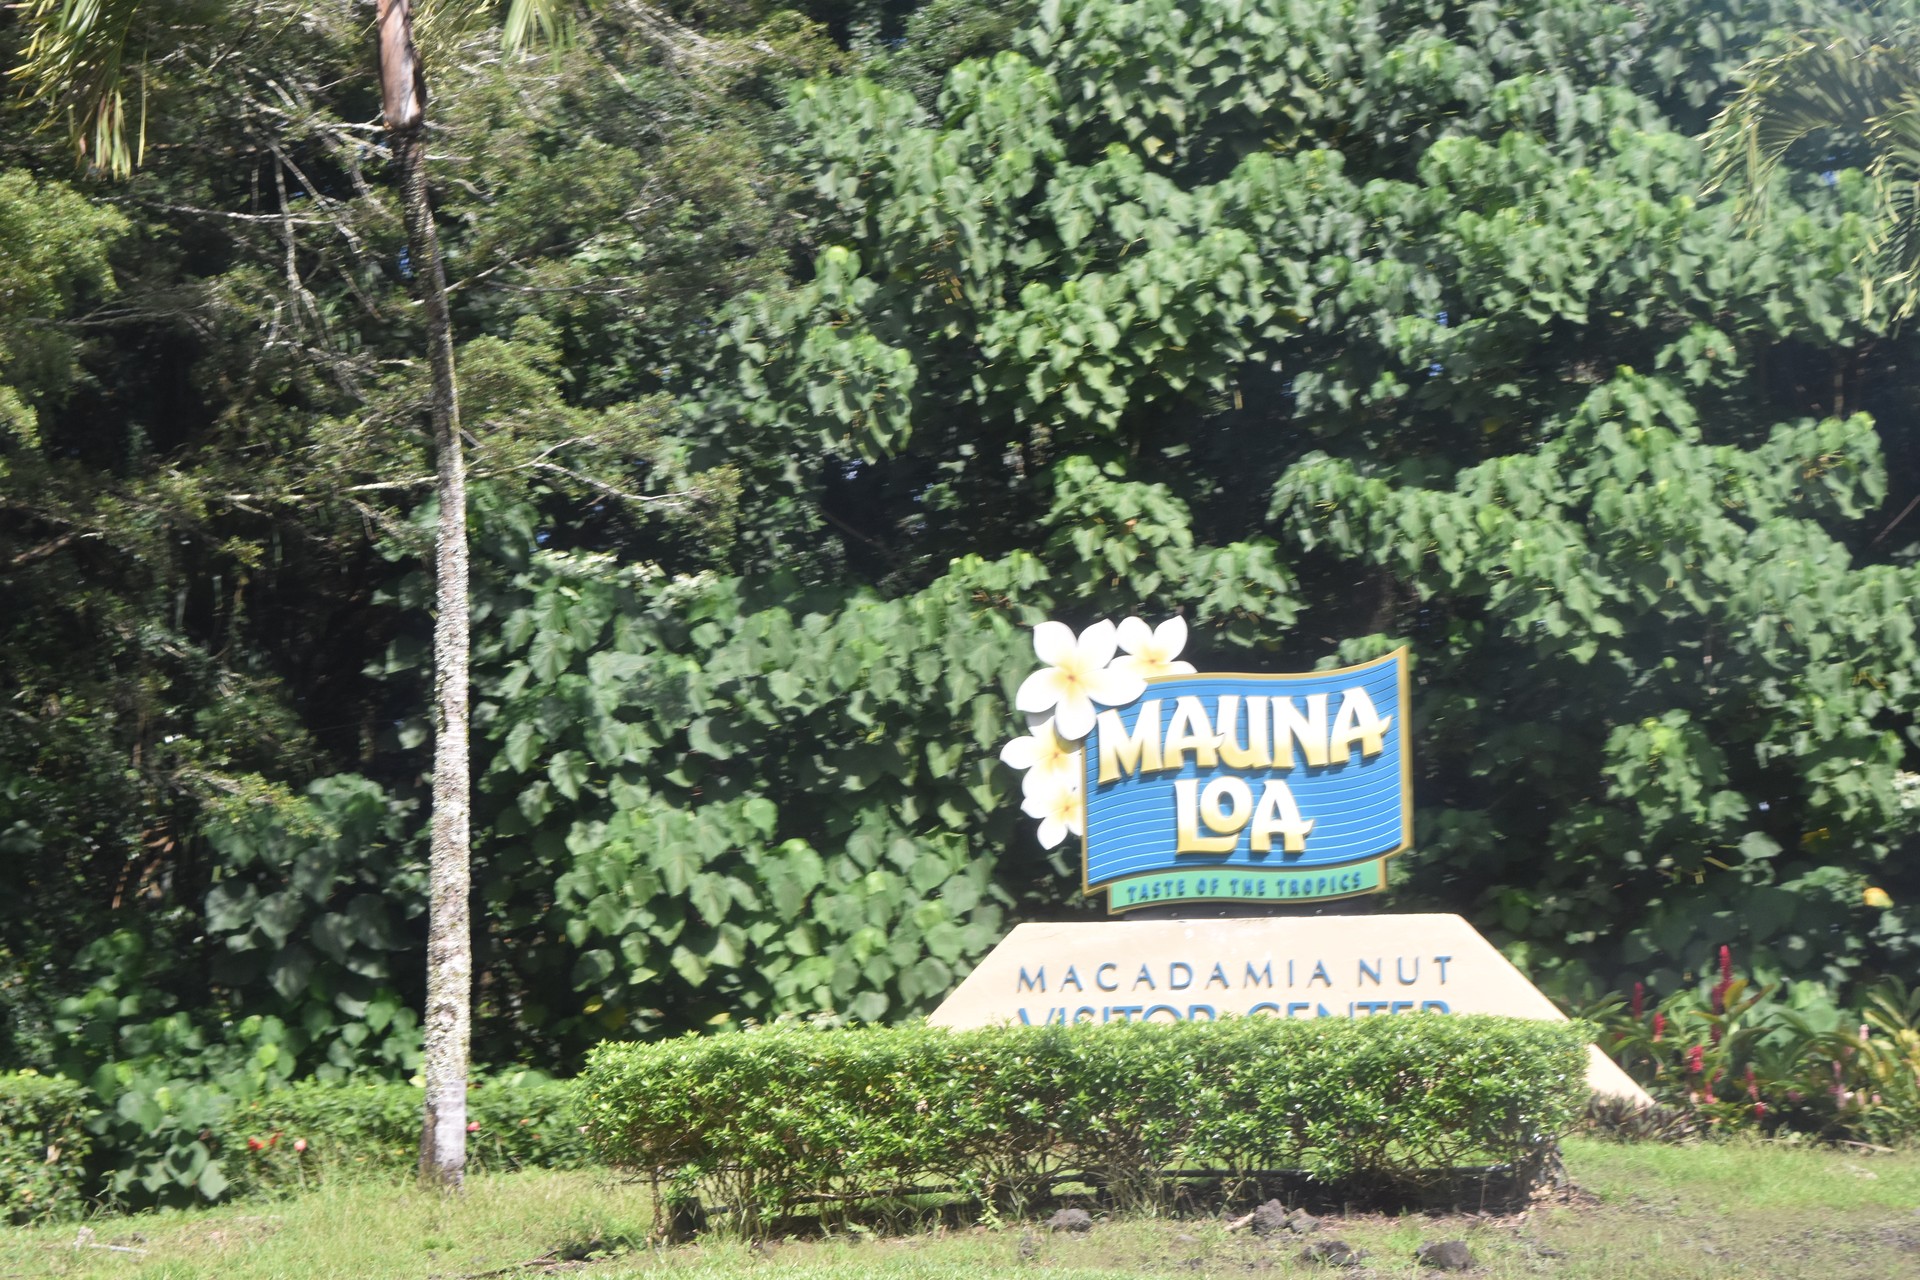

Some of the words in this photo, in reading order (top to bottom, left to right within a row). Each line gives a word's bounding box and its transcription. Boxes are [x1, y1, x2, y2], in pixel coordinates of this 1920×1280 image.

[1097, 687, 1392, 784] MAUNA
[1174, 775, 1315, 855] LOA
[1128, 878, 1186, 902] TASTE
[1197, 877, 1220, 896] OF
[1231, 877, 1266, 897] THE
[1279, 870, 1362, 896] TROPICS
[1018, 959, 1333, 993] MACADAMIA
[1358, 955, 1453, 986] NUT
